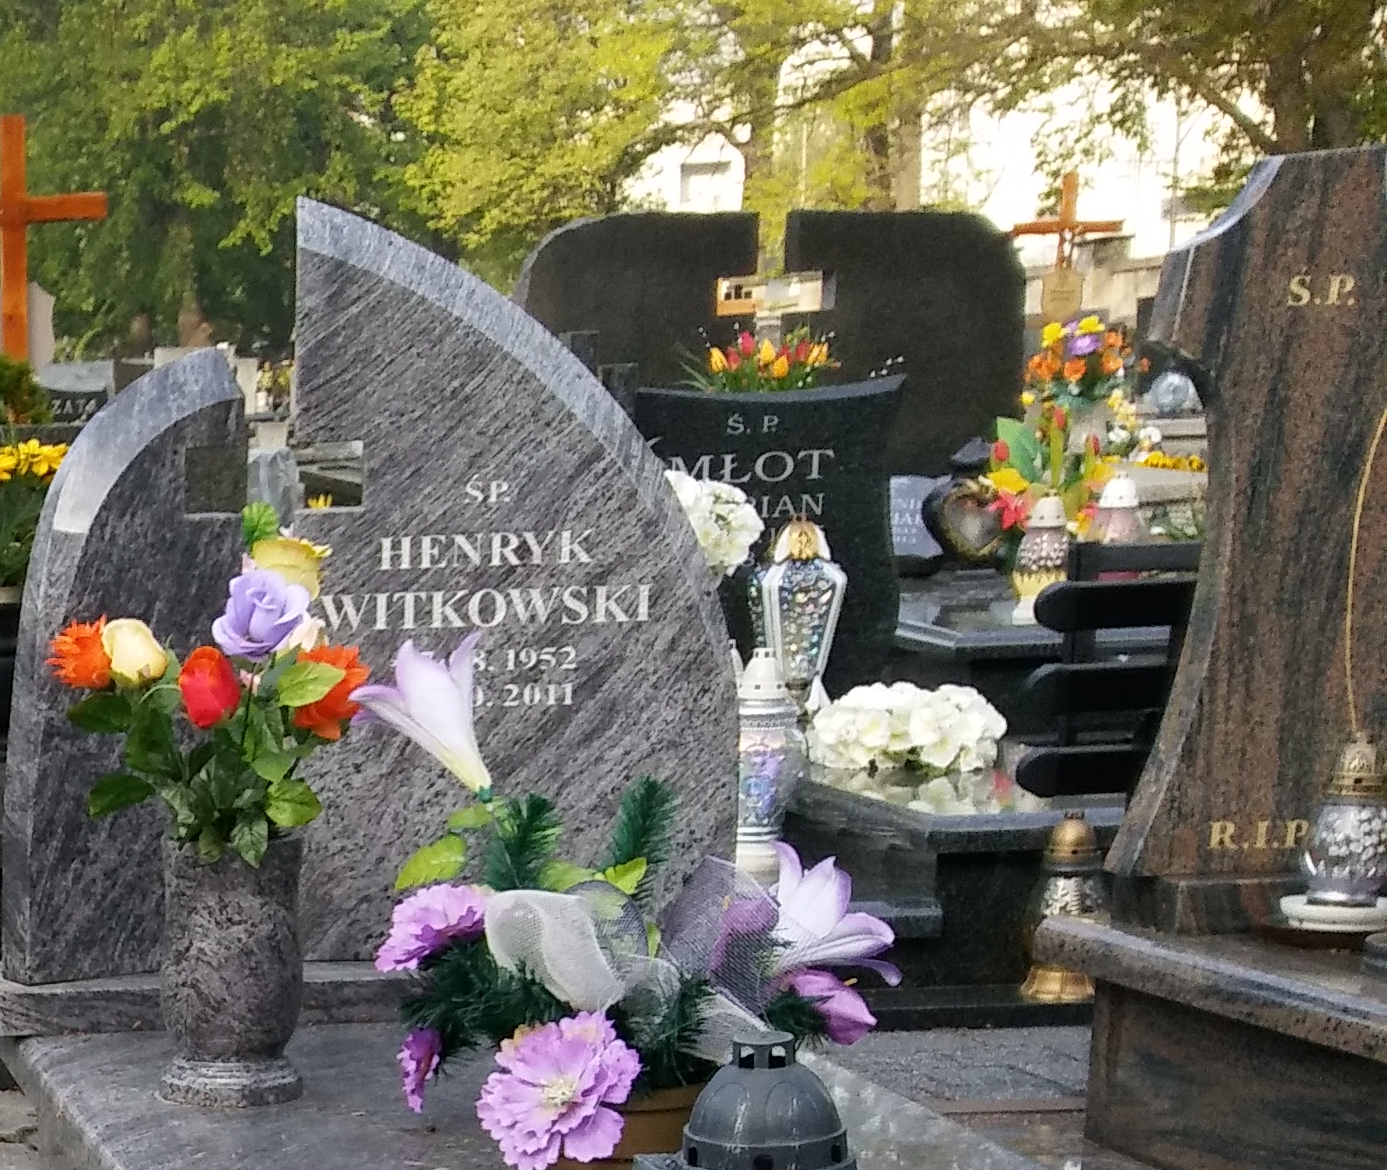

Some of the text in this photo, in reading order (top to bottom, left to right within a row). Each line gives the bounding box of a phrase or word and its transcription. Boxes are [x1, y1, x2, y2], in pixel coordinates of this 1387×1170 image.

[667, 449, 836, 484] MŁOT
[379, 528, 594, 571] HENRYK
[321, 583, 653, 632] WITKOWSKI
[505, 645, 578, 672] 1952
[502, 682, 575, 708] 2011
